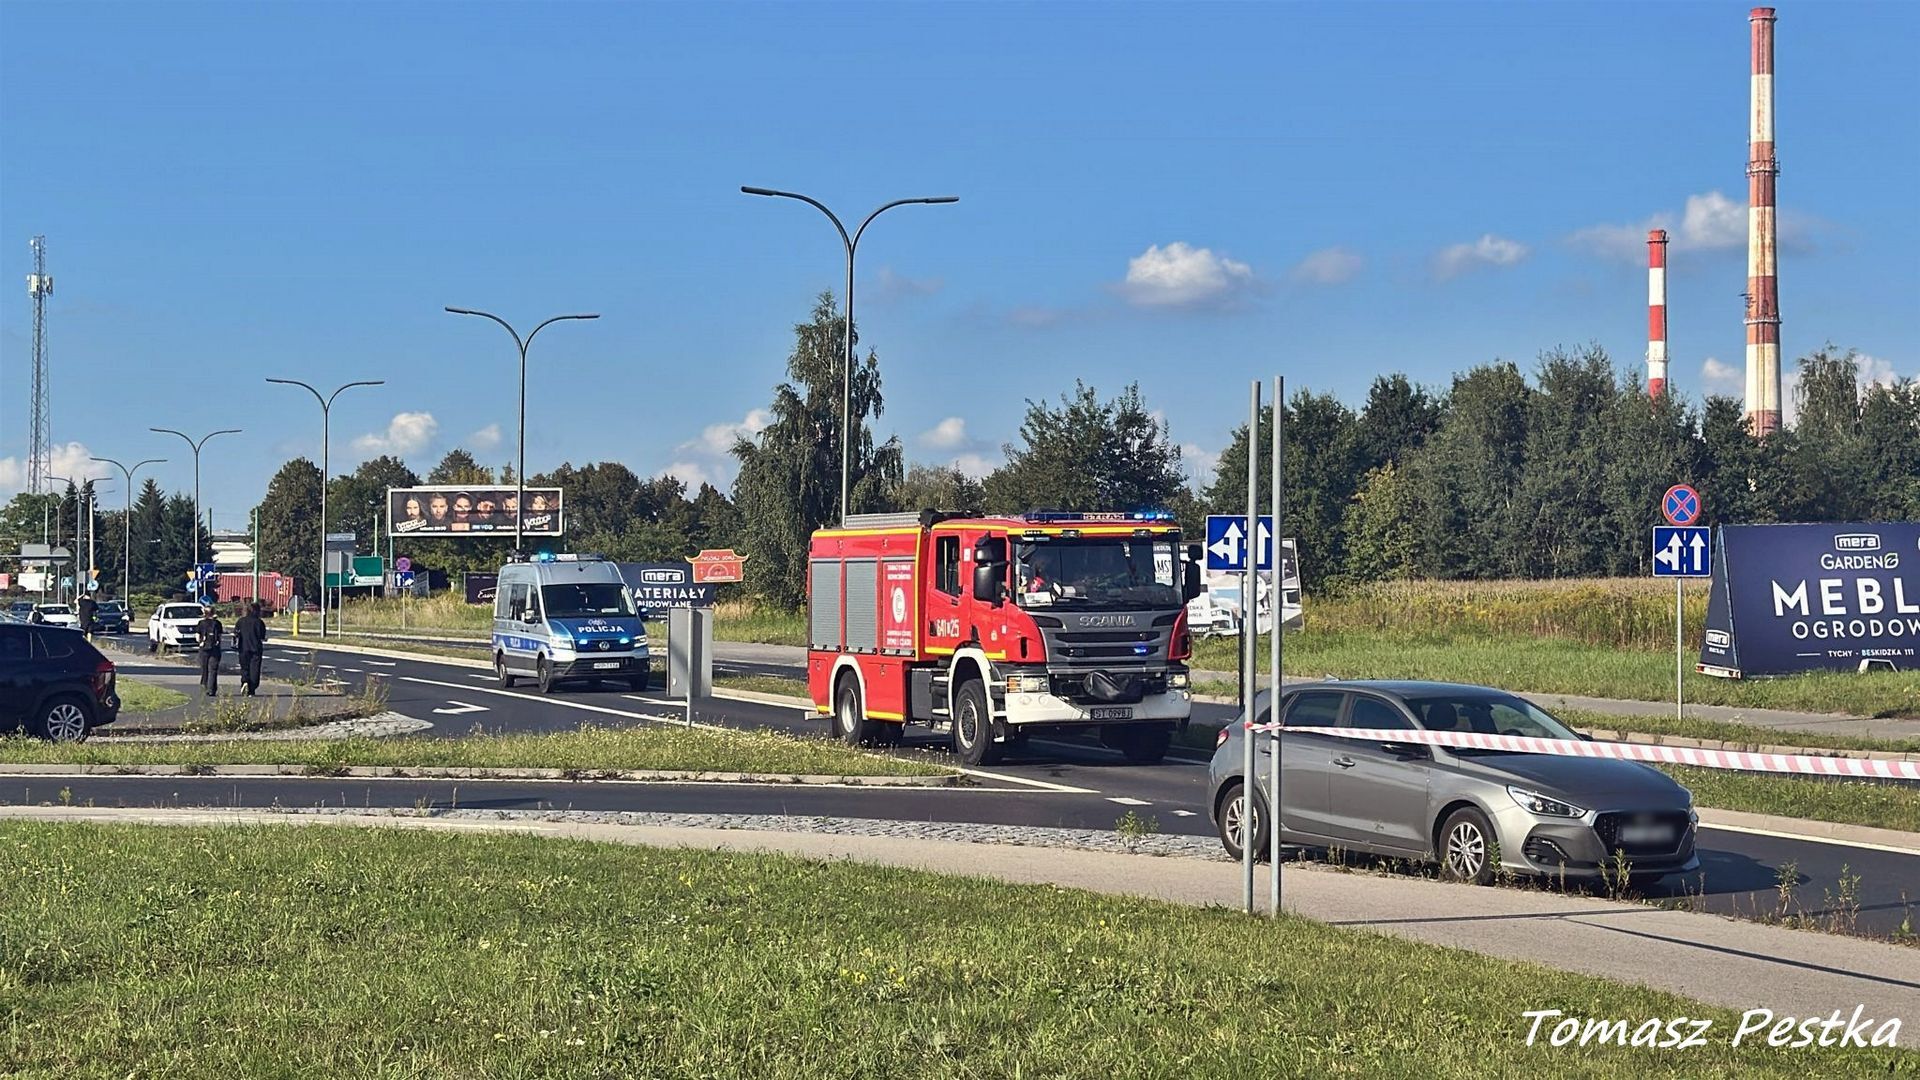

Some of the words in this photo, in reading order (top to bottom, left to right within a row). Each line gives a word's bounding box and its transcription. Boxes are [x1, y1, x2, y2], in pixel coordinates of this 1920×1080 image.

[1839, 537, 1876, 548] mera
[644, 572, 681, 581] mera
[629, 587, 706, 599] ATERIAŁY
[1079, 615, 1137, 627] SCANIA
[578, 625, 625, 634] POLICJA
[1862, 649, 1901, 657] BESKIDZKA
[1904, 648, 1914, 656] 111
